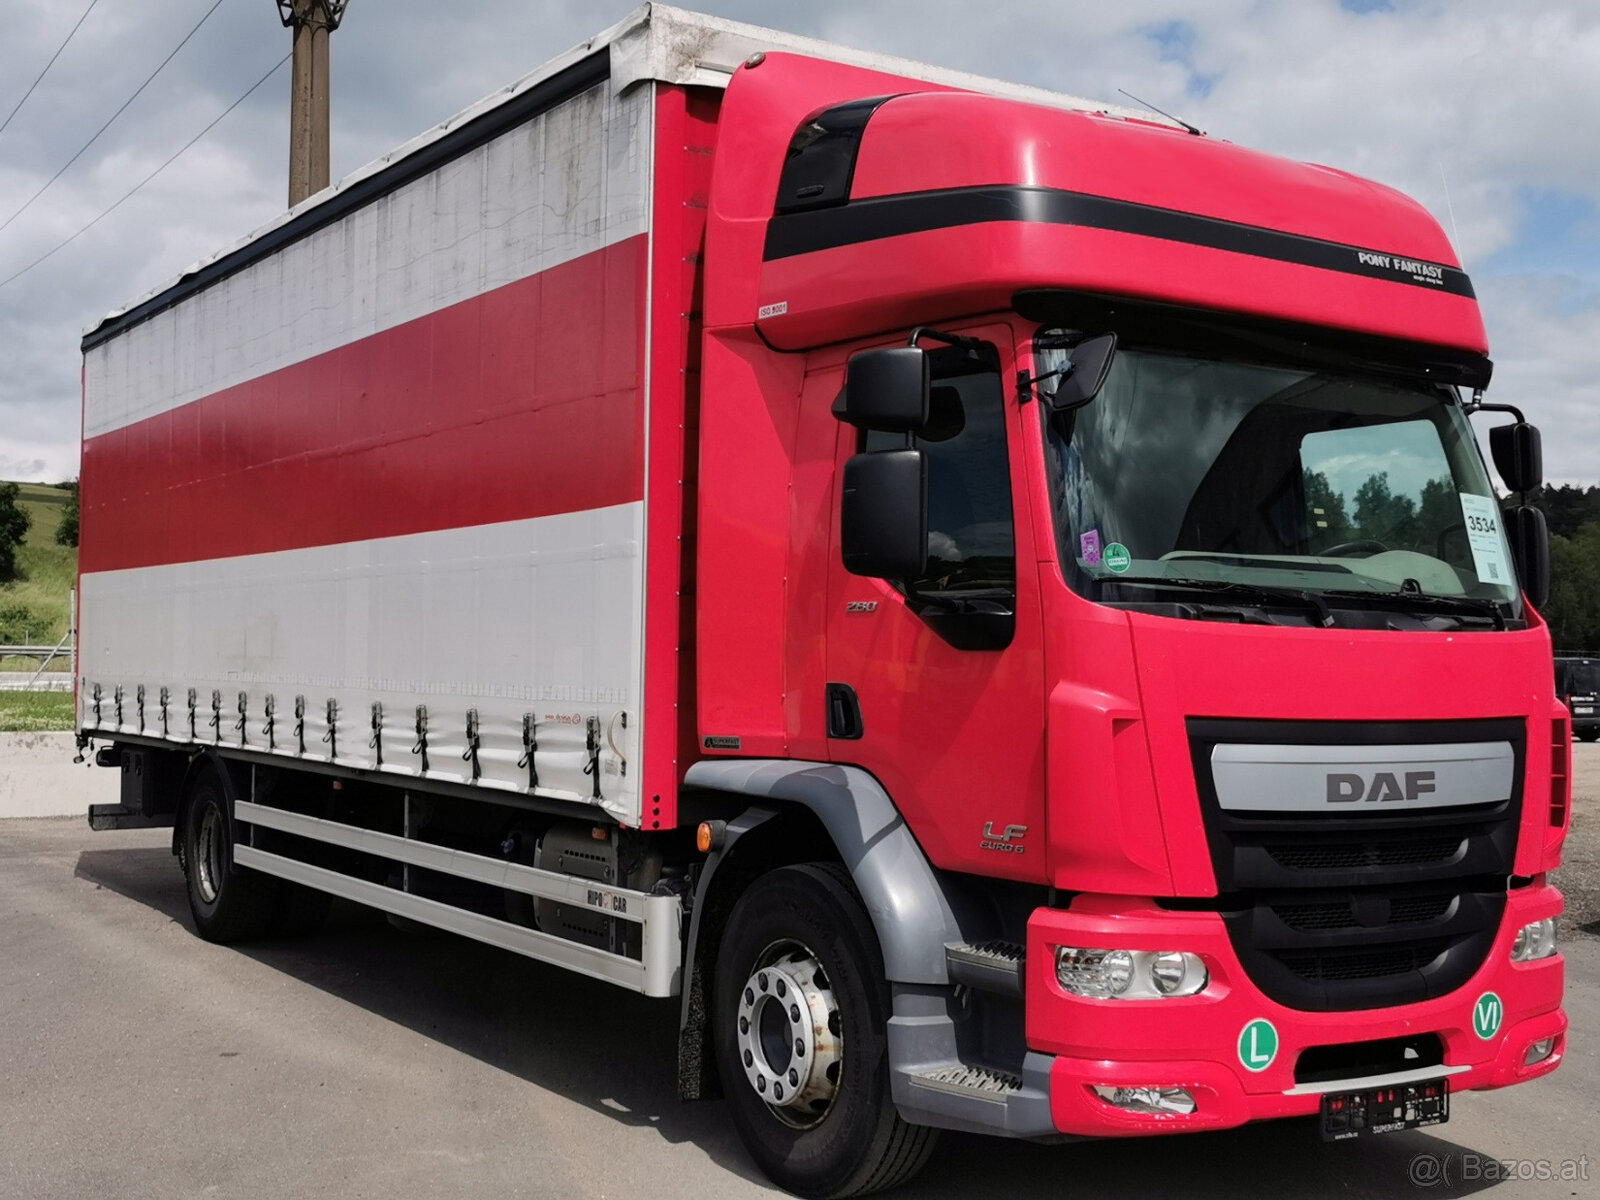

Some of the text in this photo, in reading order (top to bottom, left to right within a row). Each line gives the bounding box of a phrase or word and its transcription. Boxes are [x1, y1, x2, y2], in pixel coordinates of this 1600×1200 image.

[1358, 252, 1442, 279] PONY FANTASY
[1468, 515, 1497, 535] 3534
[1326, 770, 1436, 803] DAF
[983, 821, 1028, 842] LF
[587, 890, 627, 913] HIPO CAR
[1478, 1001, 1497, 1031] VI
[1250, 1026, 1269, 1062] L
